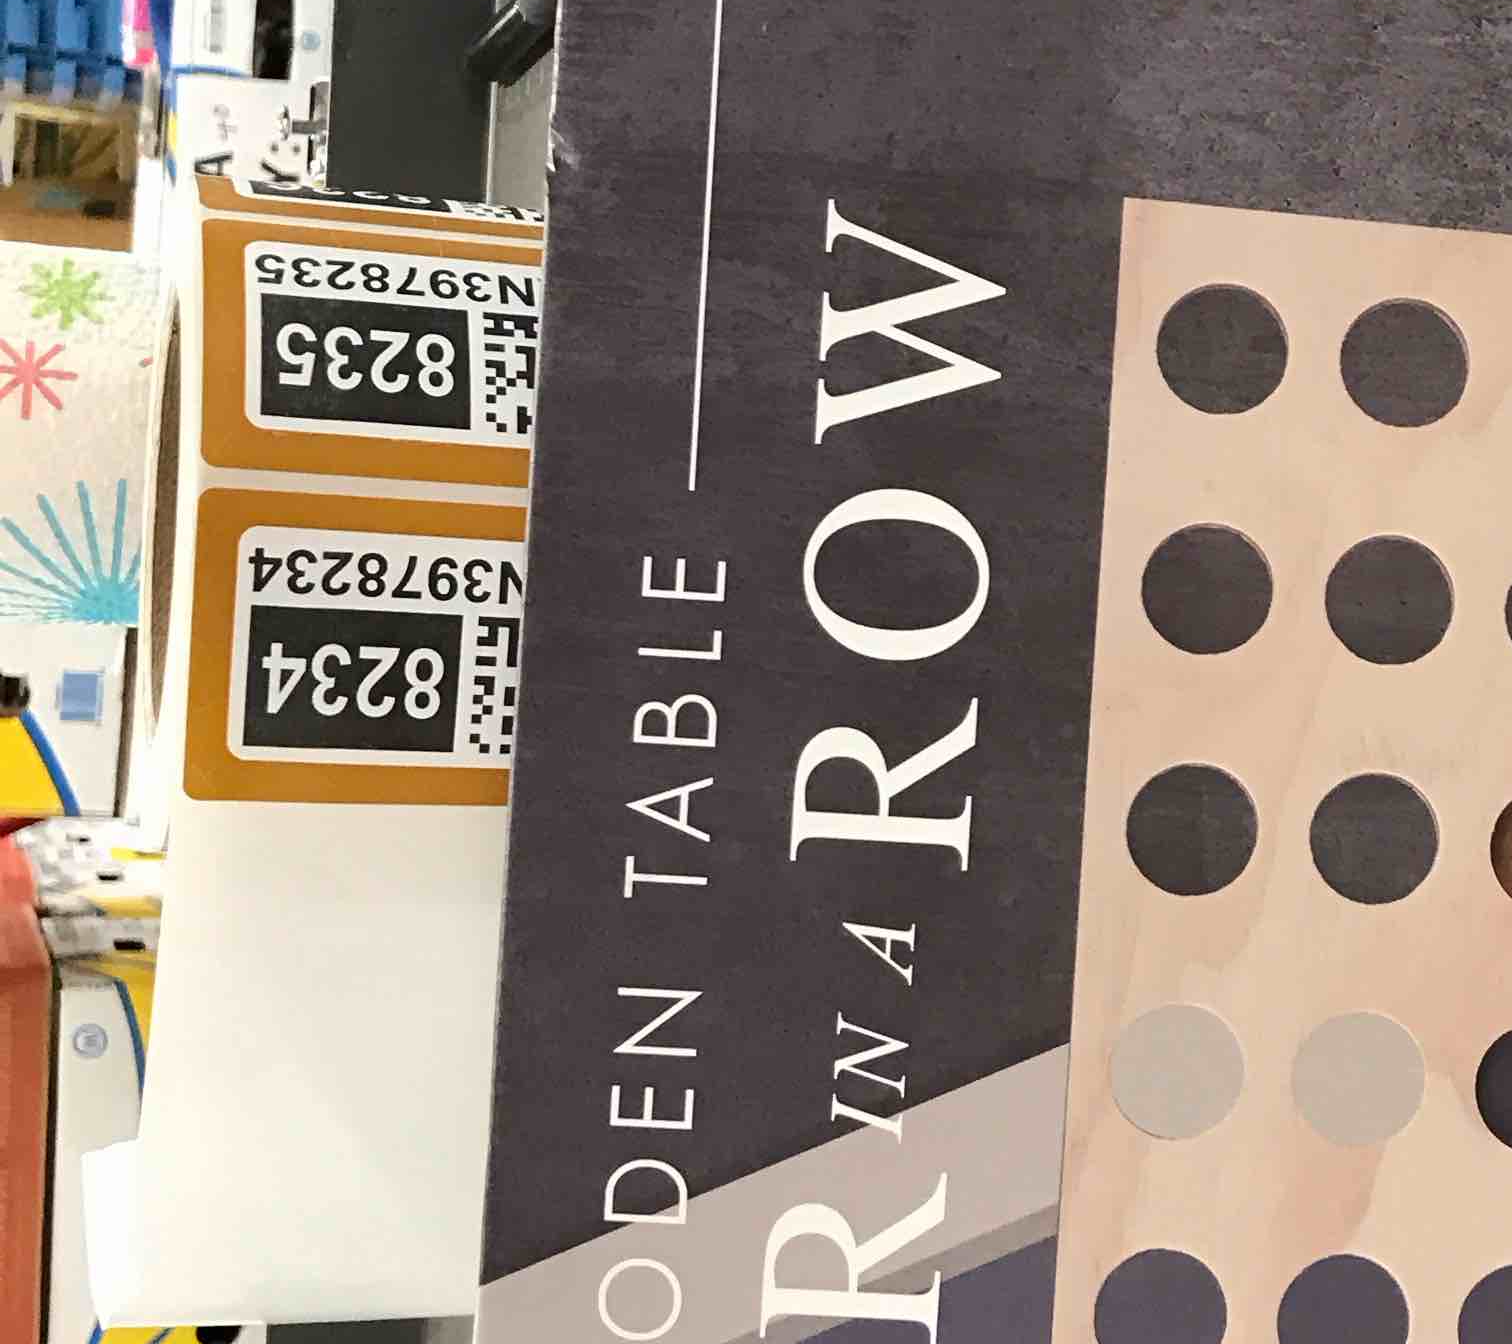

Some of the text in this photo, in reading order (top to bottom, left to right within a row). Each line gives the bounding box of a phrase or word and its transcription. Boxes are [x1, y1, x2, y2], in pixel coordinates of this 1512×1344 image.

[253, 252, 534, 306] N3978235
[274, 320, 455, 397] 8235
[788, 197, 1007, 871] ROW
[246, 545, 524, 605] N3978234
[259, 640, 446, 720] 8234
[623, 554, 727, 897] TABLE
[842, 918, 917, 985] A
[830, 1010, 910, 1143] IN
